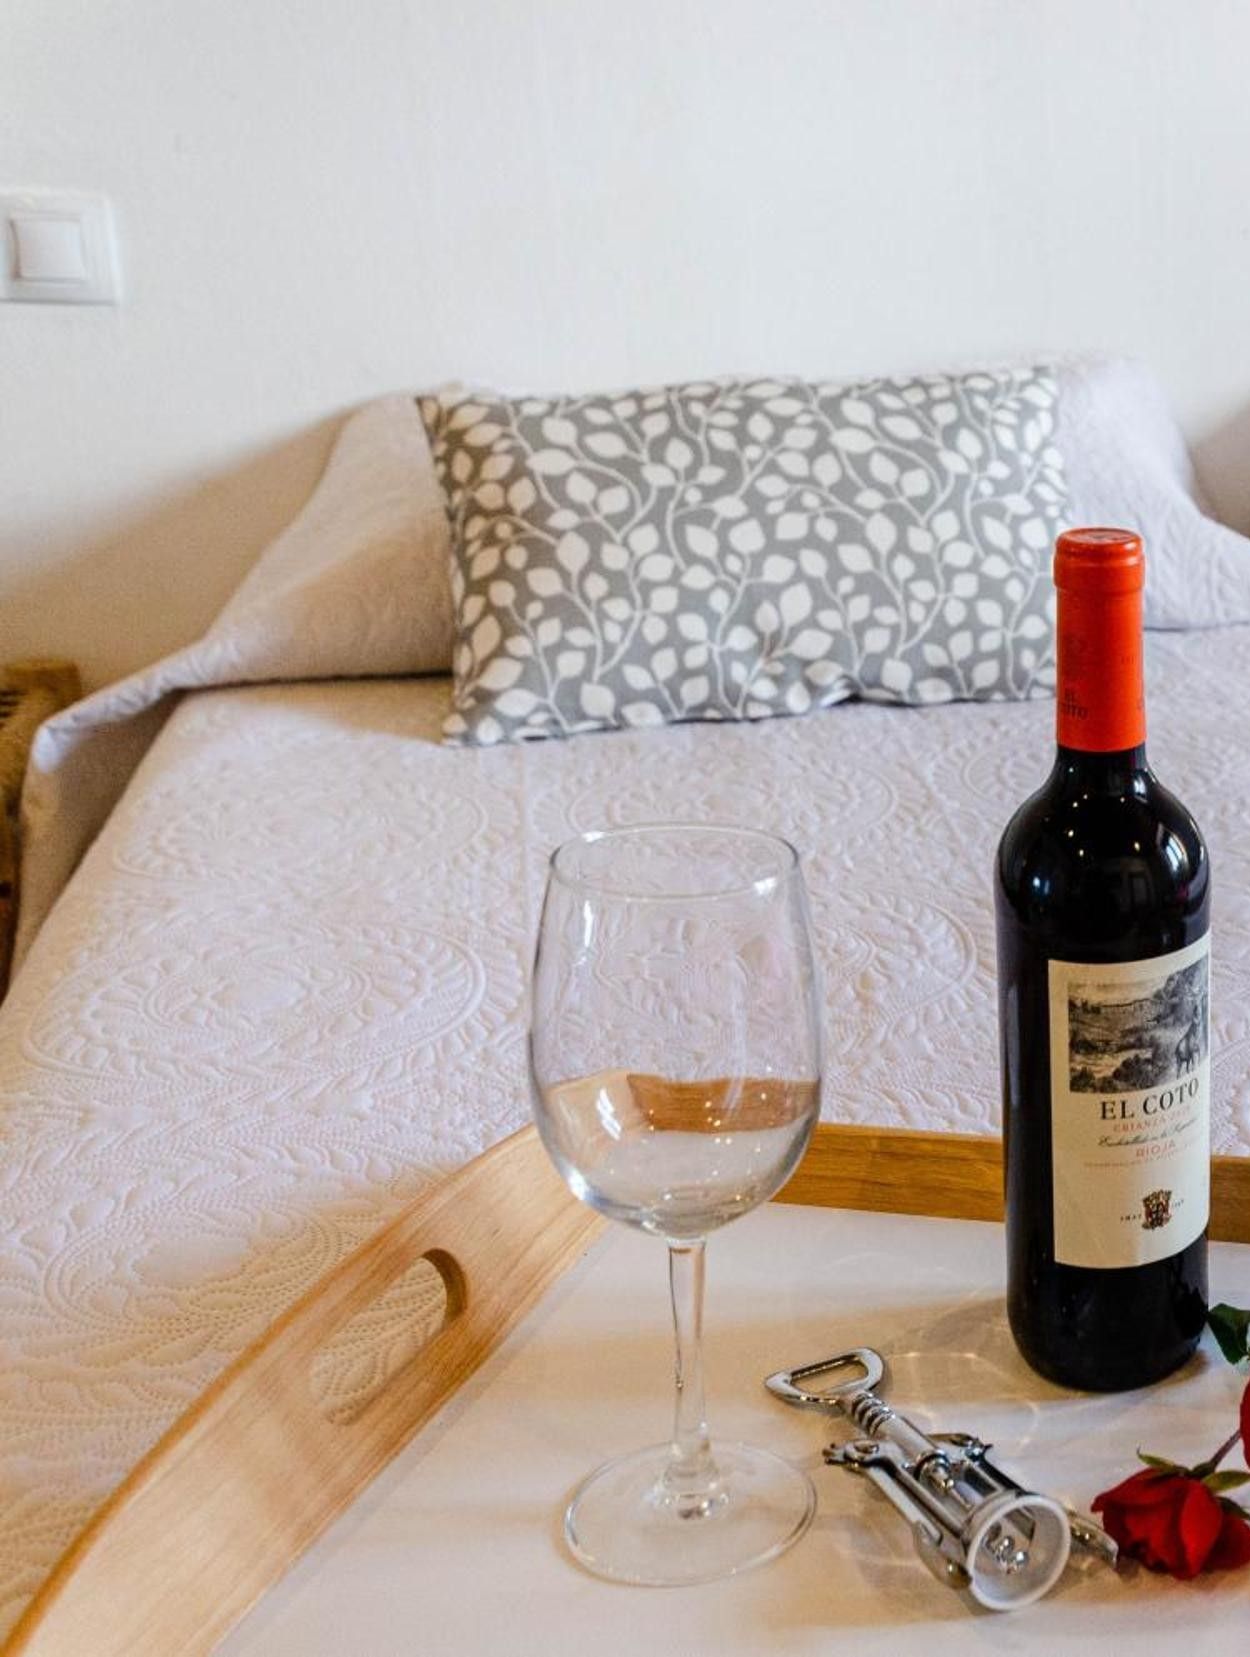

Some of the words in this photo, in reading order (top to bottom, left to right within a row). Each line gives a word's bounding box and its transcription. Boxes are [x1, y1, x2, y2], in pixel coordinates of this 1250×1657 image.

[1101, 1100, 1134, 1119] EL
[1142, 1077, 1199, 1115] COTO
[1136, 1139, 1176, 1157] RIOJA
